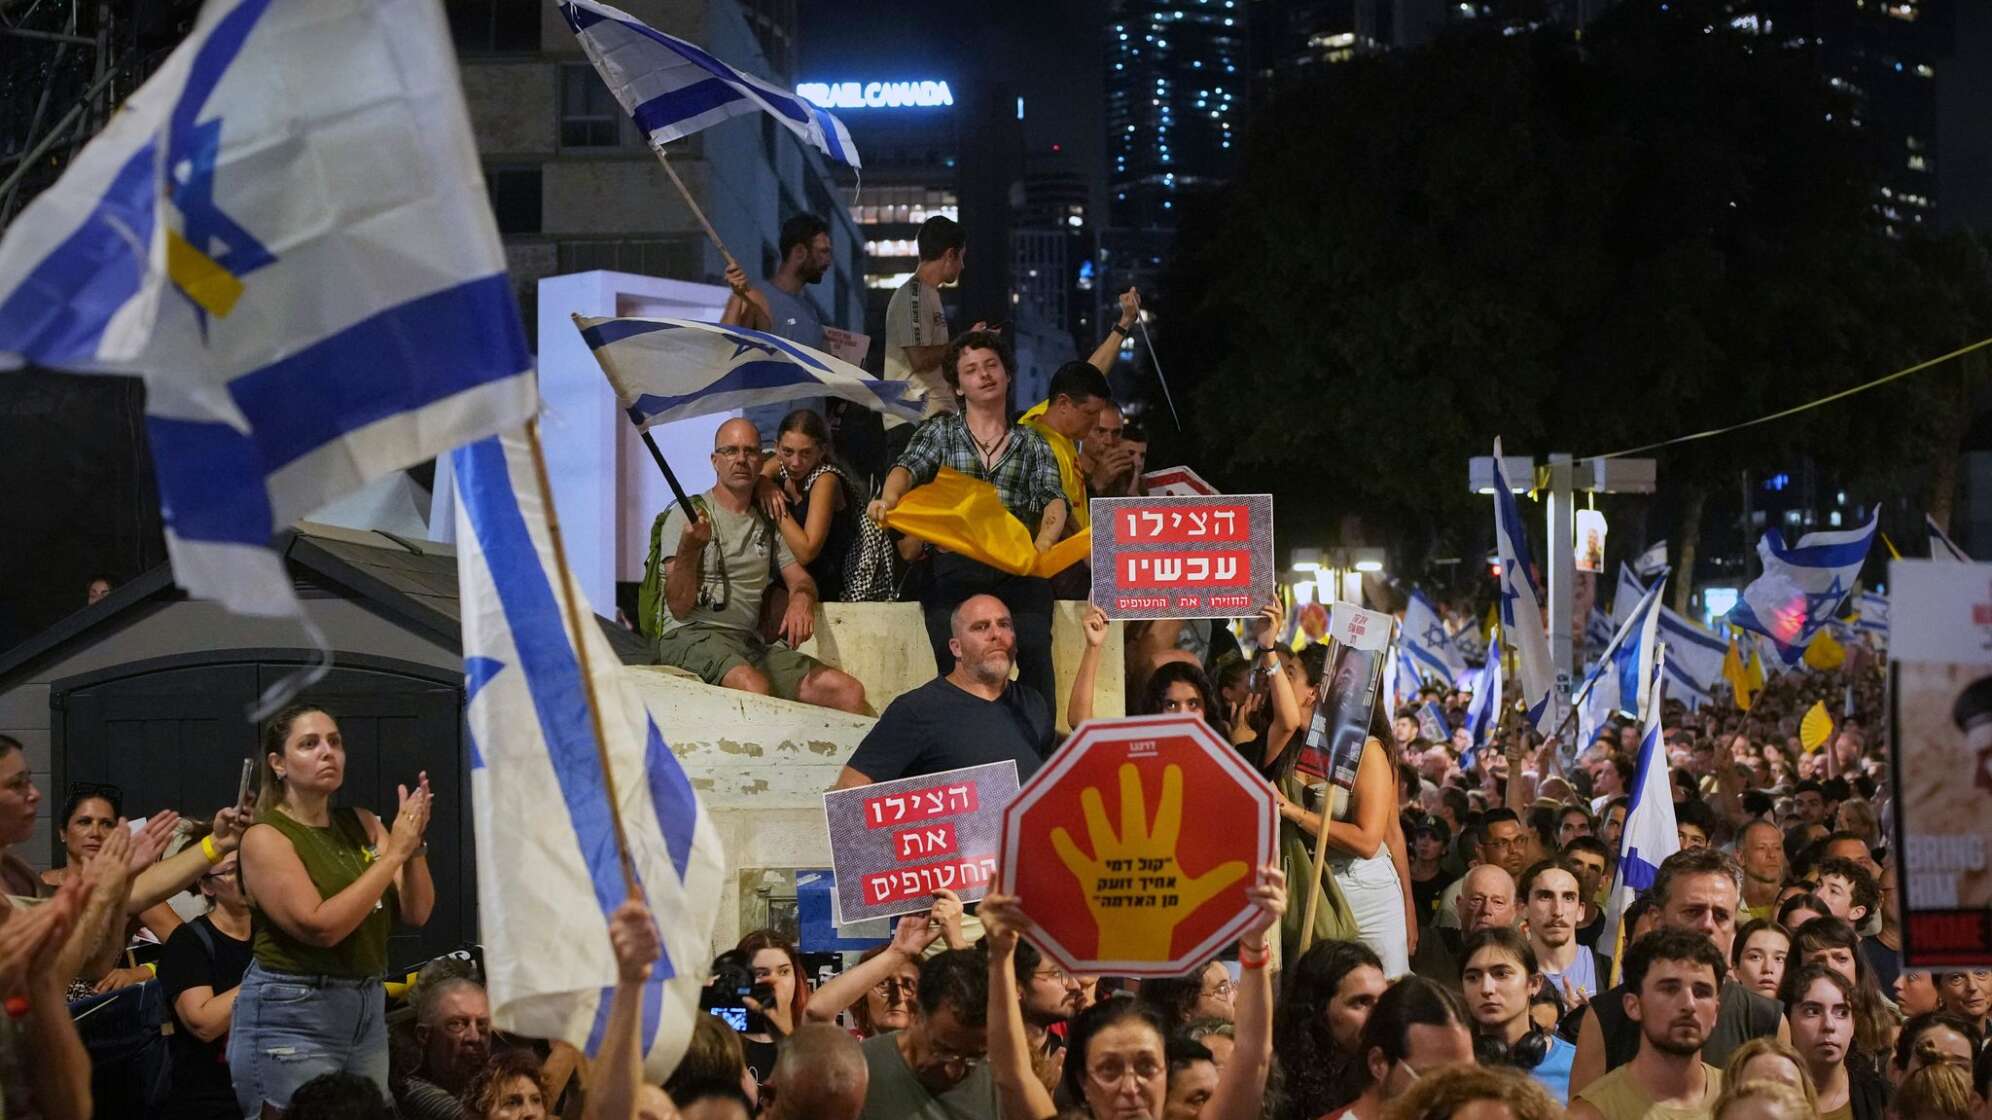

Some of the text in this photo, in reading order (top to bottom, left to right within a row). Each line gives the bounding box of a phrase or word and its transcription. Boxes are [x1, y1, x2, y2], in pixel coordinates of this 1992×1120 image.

[865, 80, 954, 107] CANADA
[1127, 510, 1236, 537] הצילו
[1127, 557, 1237, 582] עכשיו
[1120, 596, 1249, 608] החזירו את החטופים
[872, 785, 968, 823] הצילו
[902, 829, 948, 856] את
[1104, 859, 1133, 871] דמי
[871, 858, 997, 901] החטופים
[1097, 876, 1177, 892] אחיך זועק
[1161, 894, 1179, 908] מן
